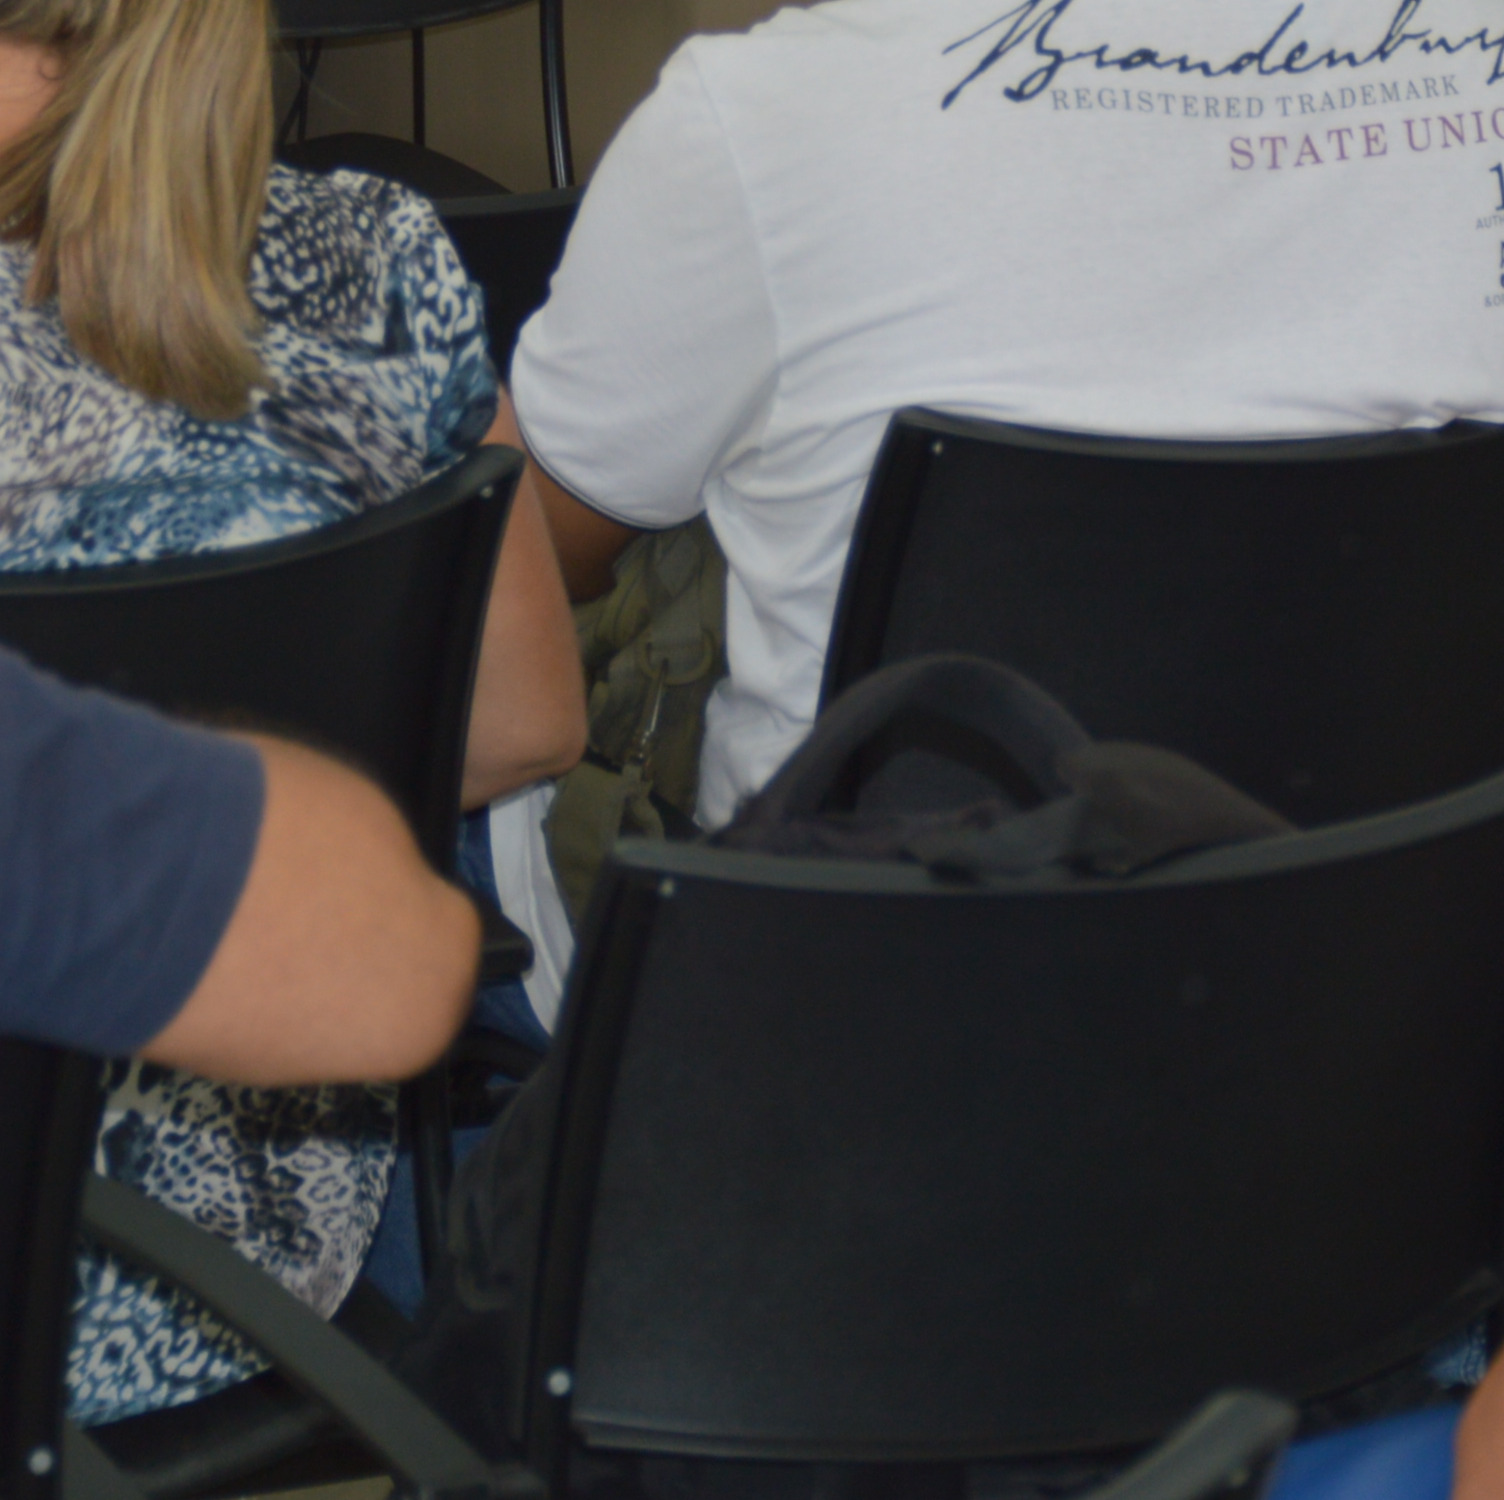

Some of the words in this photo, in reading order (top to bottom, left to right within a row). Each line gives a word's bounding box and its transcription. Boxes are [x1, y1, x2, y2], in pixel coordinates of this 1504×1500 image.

[1051, 87, 1264, 119] REGISTERED
[1275, 74, 1460, 117] TRADEMARK
[1229, 124, 1388, 171] STATE
